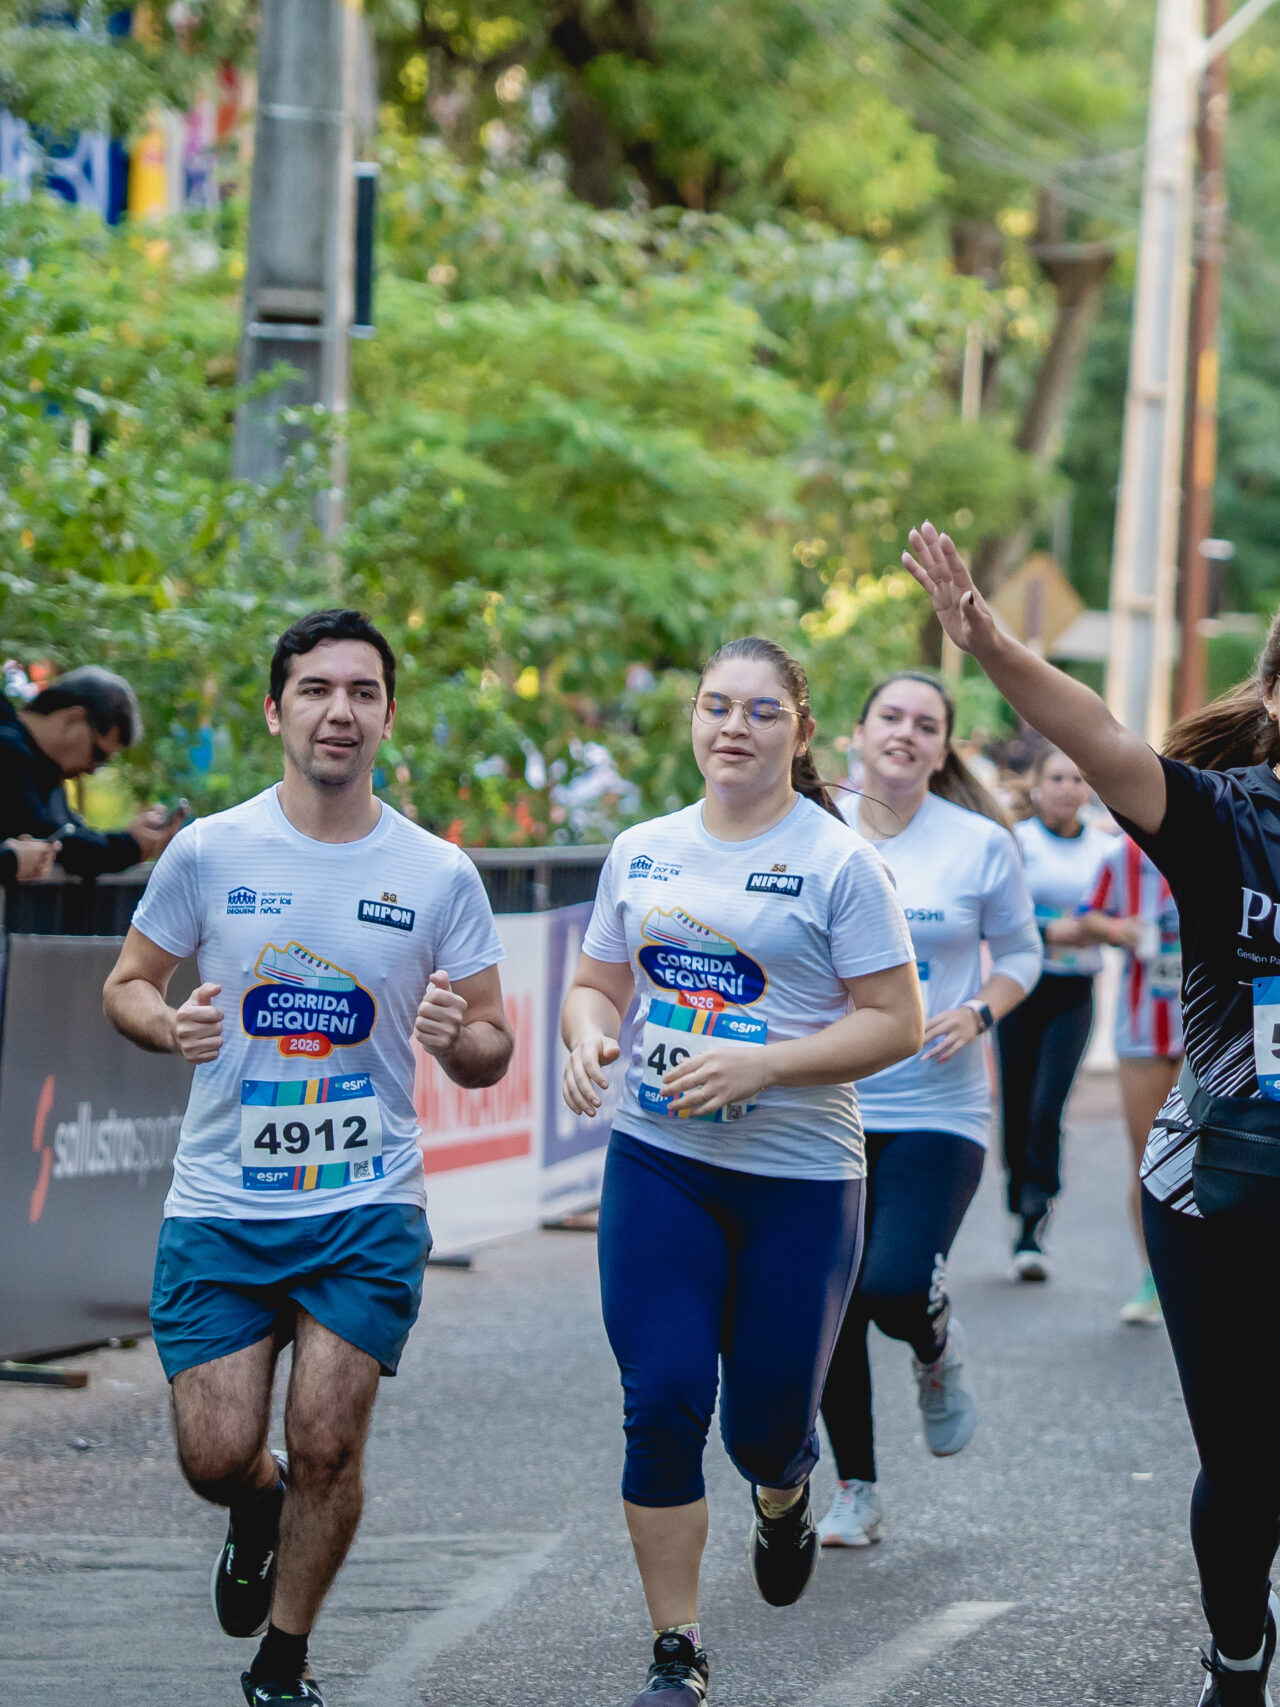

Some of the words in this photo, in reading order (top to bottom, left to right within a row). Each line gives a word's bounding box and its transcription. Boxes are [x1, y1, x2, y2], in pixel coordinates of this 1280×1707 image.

[750, 874, 800, 892] NIPON
[260, 897, 276, 906] por
[279, 896, 292, 905] los
[260, 905, 282, 915] niños
[362, 902, 412, 925] NIPON
[657, 952, 736, 975] CORRIDA
[267, 992, 350, 1014] CORRIDA
[256, 1009, 358, 1036] DEQUENÍ
[288, 1038, 320, 1052] 2026
[253, 1115, 369, 1155] 4912
